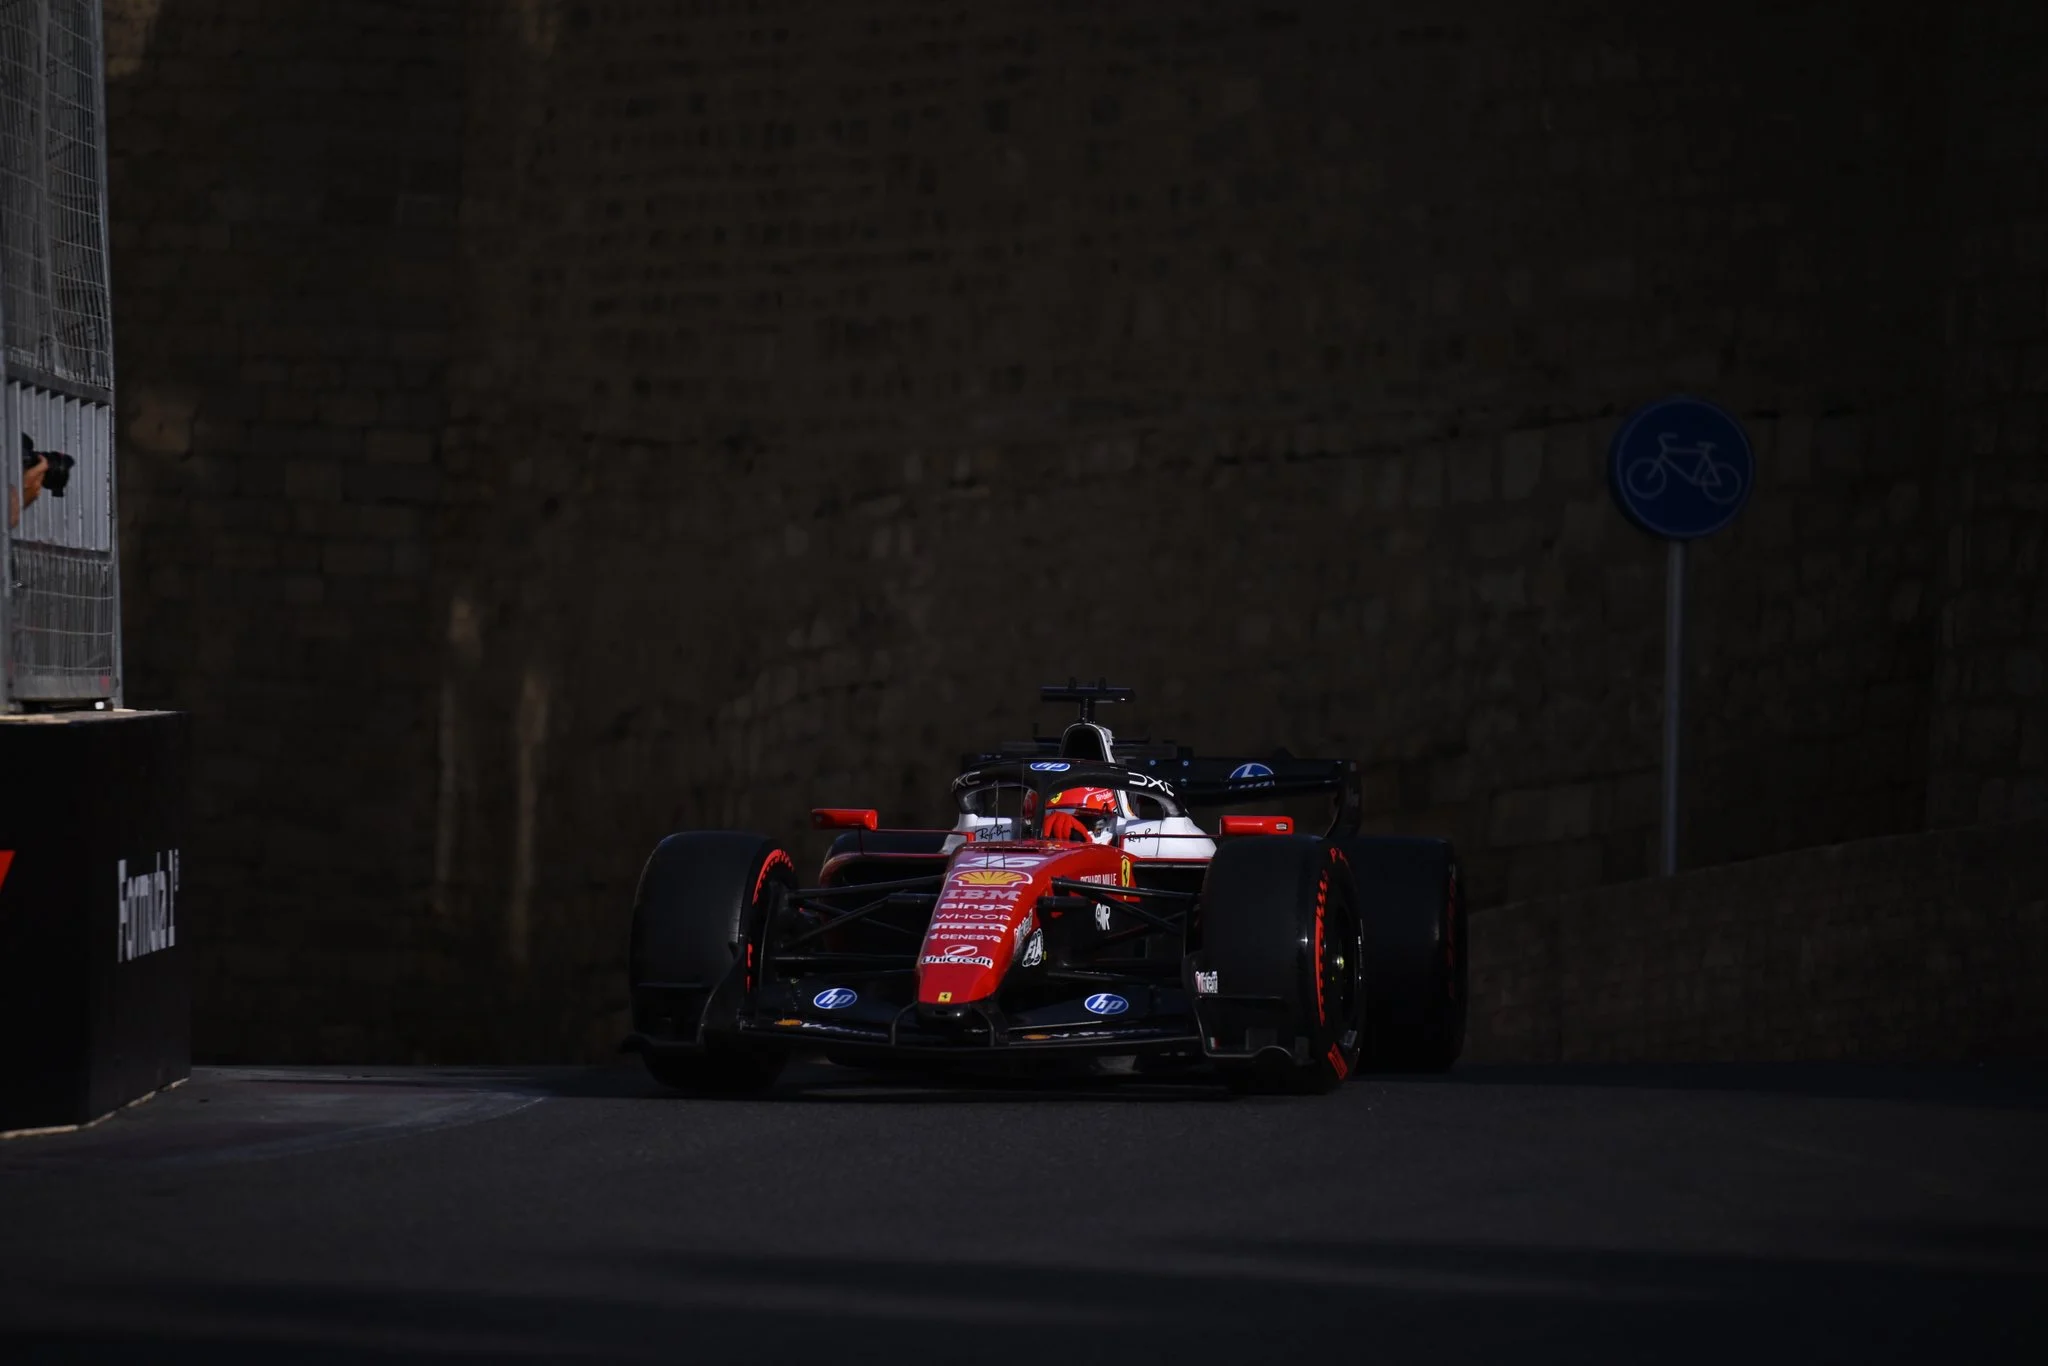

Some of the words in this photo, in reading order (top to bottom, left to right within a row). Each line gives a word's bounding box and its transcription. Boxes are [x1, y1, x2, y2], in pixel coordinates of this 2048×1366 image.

[943, 889, 1021, 902] IBM
[940, 933, 1003, 943] GENESYS
[815, 988, 856, 1009] hp
[1086, 993, 1127, 1014] hp
